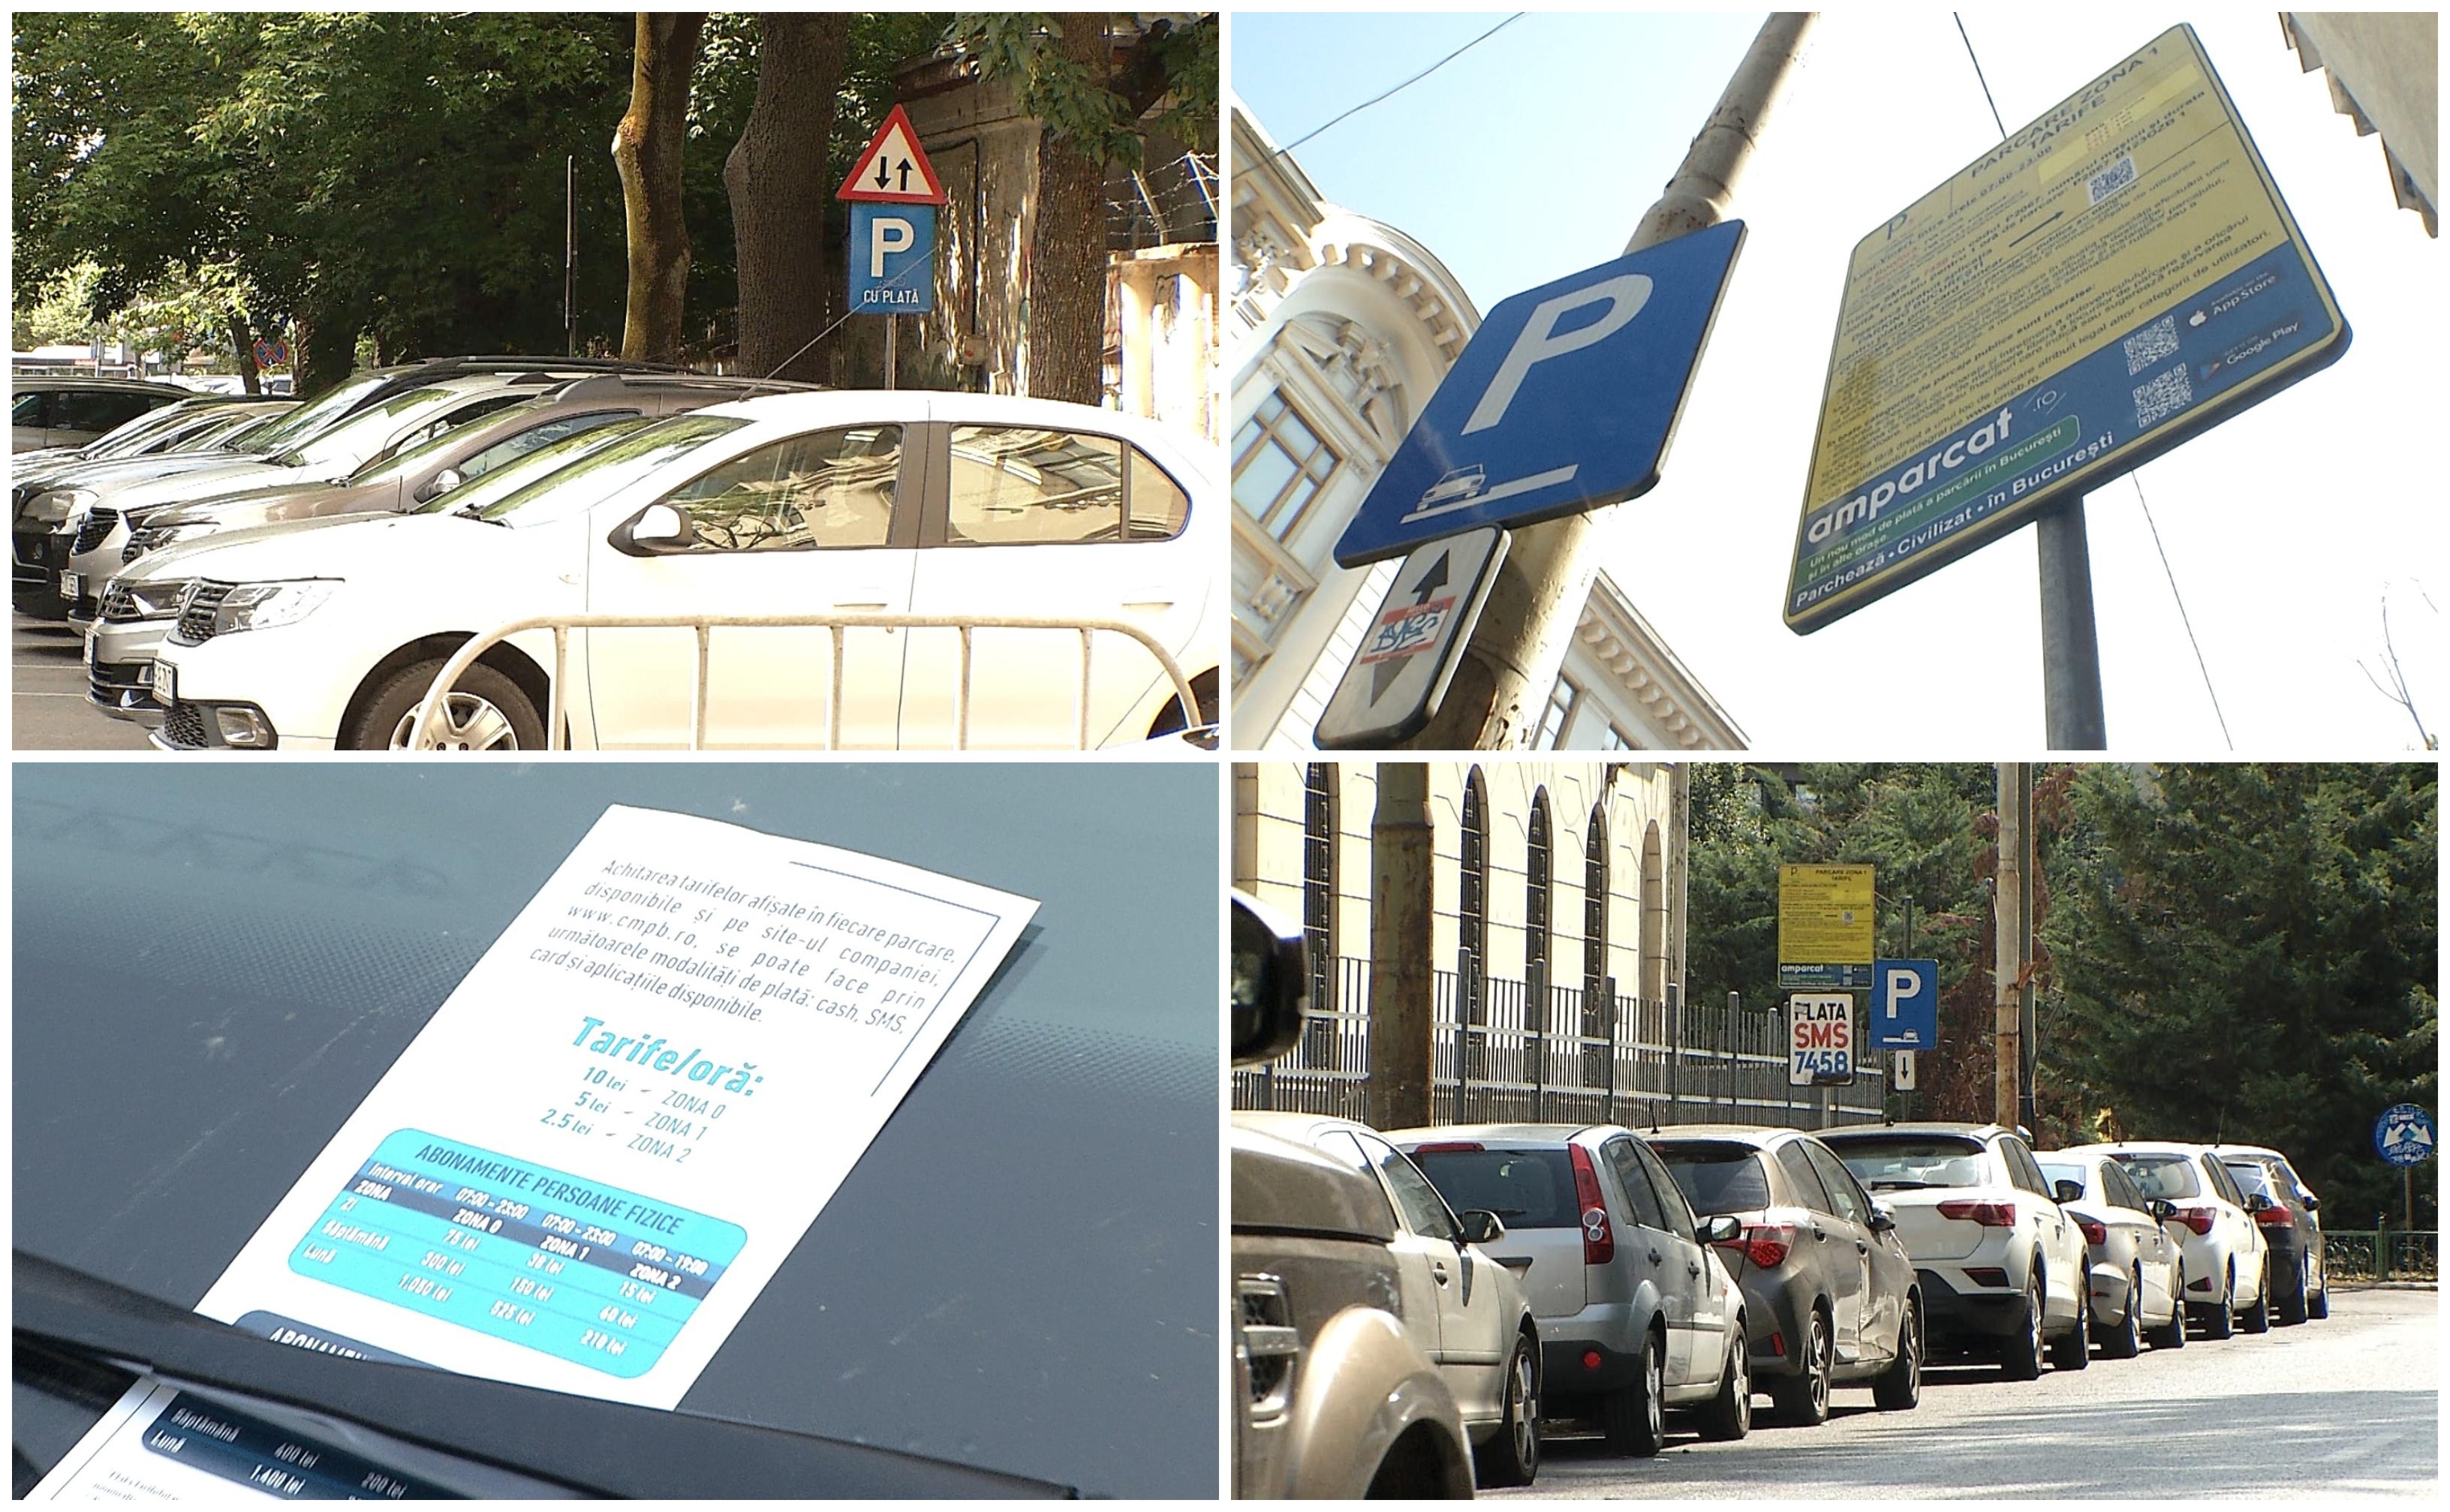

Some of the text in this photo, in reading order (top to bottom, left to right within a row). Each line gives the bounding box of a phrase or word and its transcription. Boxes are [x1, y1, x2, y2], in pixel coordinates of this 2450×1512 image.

[1971, 109, 2066, 178] PARCARE
[2081, 59, 2144, 104] ZONA
[2150, 46, 2158, 56] 1
[2030, 95, 2105, 149] TARIFE
[871, 218, 914, 278] P
[864, 287, 920, 303] CU PLATĂ
[2214, 296, 2240, 315] App
[2241, 276, 2275, 299] Store
[1462, 273, 1655, 436] P
[2226, 338, 2271, 365] Google
[2272, 323, 2298, 340] Play
[1809, 410, 2011, 543] amparcat
[1810, 427, 2061, 568] Un nou mod de plată a parcării în București
[1797, 431, 2112, 606] Parchează Civilizat în București
[585, 882, 682, 912] disponibile
[694, 909, 713, 924] și
[722, 918, 749, 932] pe
[762, 924, 828, 952] site-ul
[603, 860, 679, 886] Achitarea
[679, 876, 748, 904] tarifelor
[748, 895, 806, 918] afișate
[806, 906, 825, 924] în
[826, 912, 886, 942] fiecare
[530, 948, 761, 1021] card și aplicațiile disponibile.
[549, 928, 649, 959] următoarele
[650, 952, 740, 987] modalități
[738, 974, 761, 992] de
[760, 982, 814, 1007] plată:
[716, 943, 739, 957] se
[751, 952, 810, 976] poate
[825, 968, 869, 993] face
[880, 990, 926, 1009] prin
[1781, 964, 1824, 974] amparcat
[1886, 969, 1922, 1019] P
[574, 1017, 762, 1096] Tarife/oră:
[1794, 1022, 1850, 1049] SMS
[1794, 1051, 1849, 1075] 7458
[574, 1091, 708, 1141] 5 lei ZONA 1
[583, 1066, 727, 1120] 10 lei ZONA 0
[540, 1108, 692, 1163] 2.5 lei ZONA 2
[369, 1164, 708, 1275] Interval orar 07:00 23:00 07:00 23:00 07:00 19:00
[416, 1145, 684, 1234] ABONAMENTE PERSOANE FIZICE
[355, 1180, 681, 1289] ZONA ZONA 0 ZONA 1 ZONA 2
[444, 1229, 463, 1245] 75
[620, 1282, 638, 1297] 15
[636, 1287, 656, 1303] lei
[511, 1277, 535, 1295] 150
[618, 1312, 637, 1327] lei
[607, 1338, 625, 1354] lei
